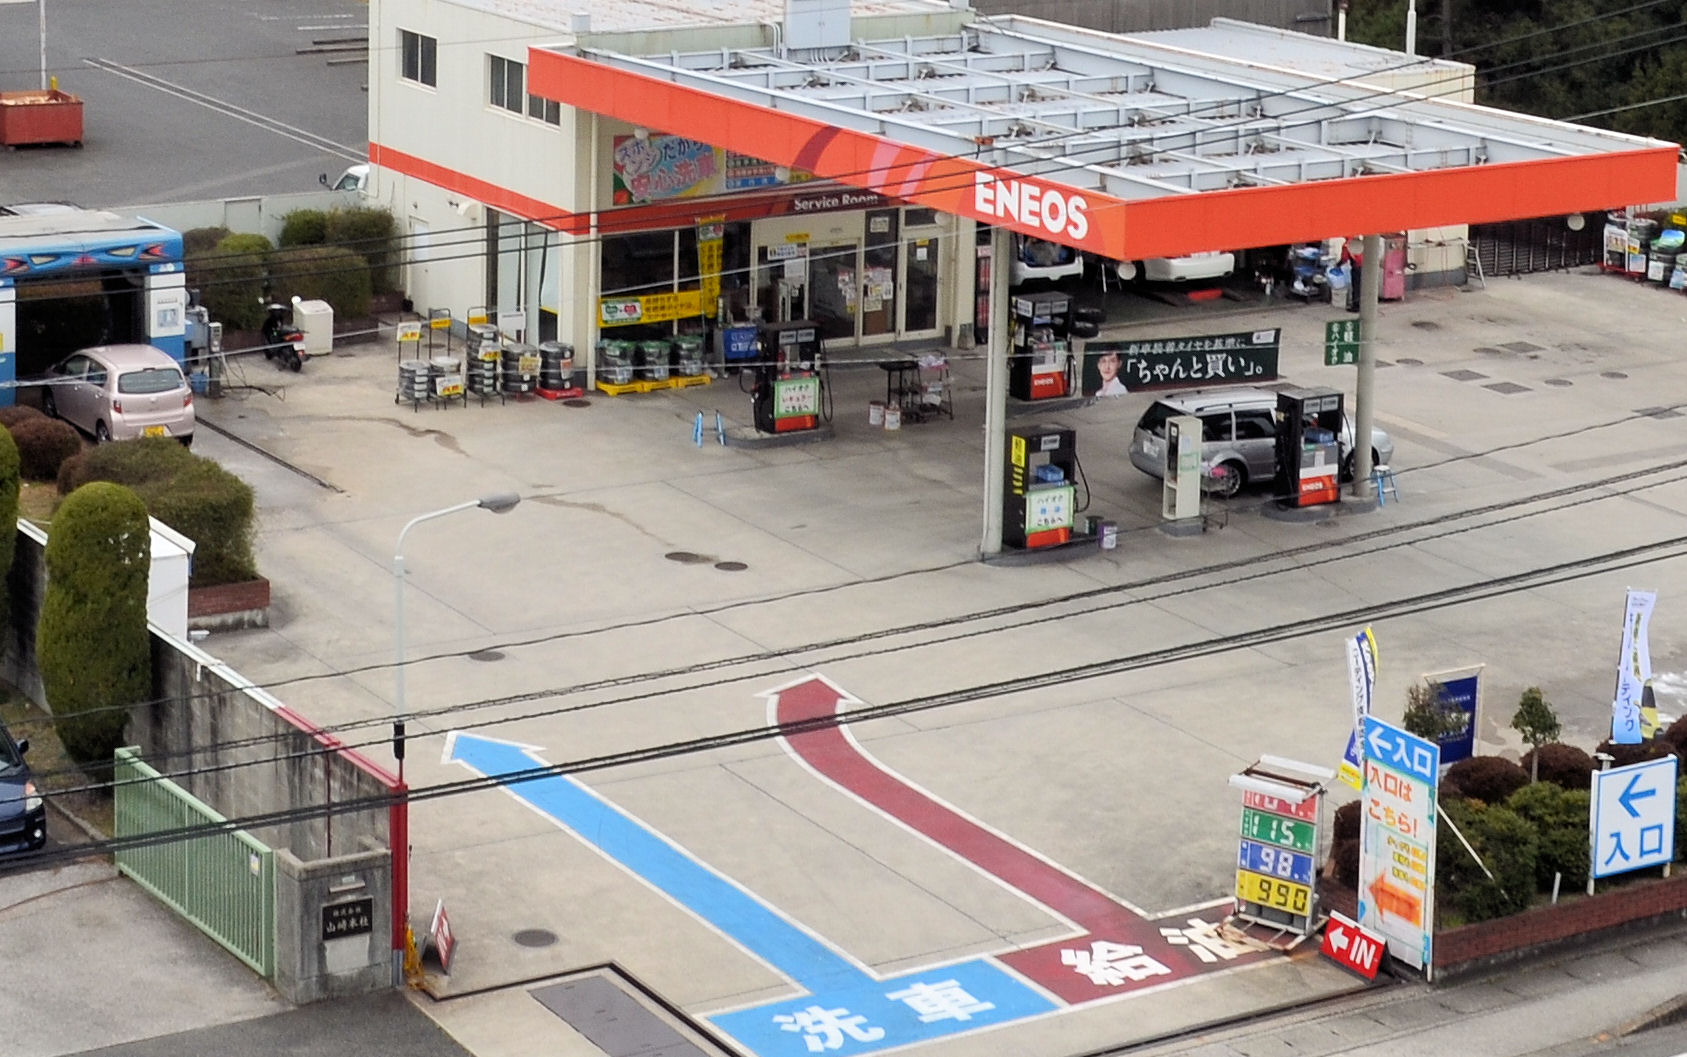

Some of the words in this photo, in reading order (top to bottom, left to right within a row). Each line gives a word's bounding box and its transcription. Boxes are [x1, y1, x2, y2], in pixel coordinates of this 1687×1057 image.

[794, 196, 839, 211] Service
[842, 194, 879, 208] Room
[975, 171, 1089, 240] ENEOS
[1392, 736, 1433, 778] 入口
[1370, 766, 1412, 802] 入口は
[1604, 823, 1664, 866] 入口
[1258, 878, 1308, 912] 990
[1349, 935, 1376, 970] IN
[773, 979, 996, 1052] 洗車
